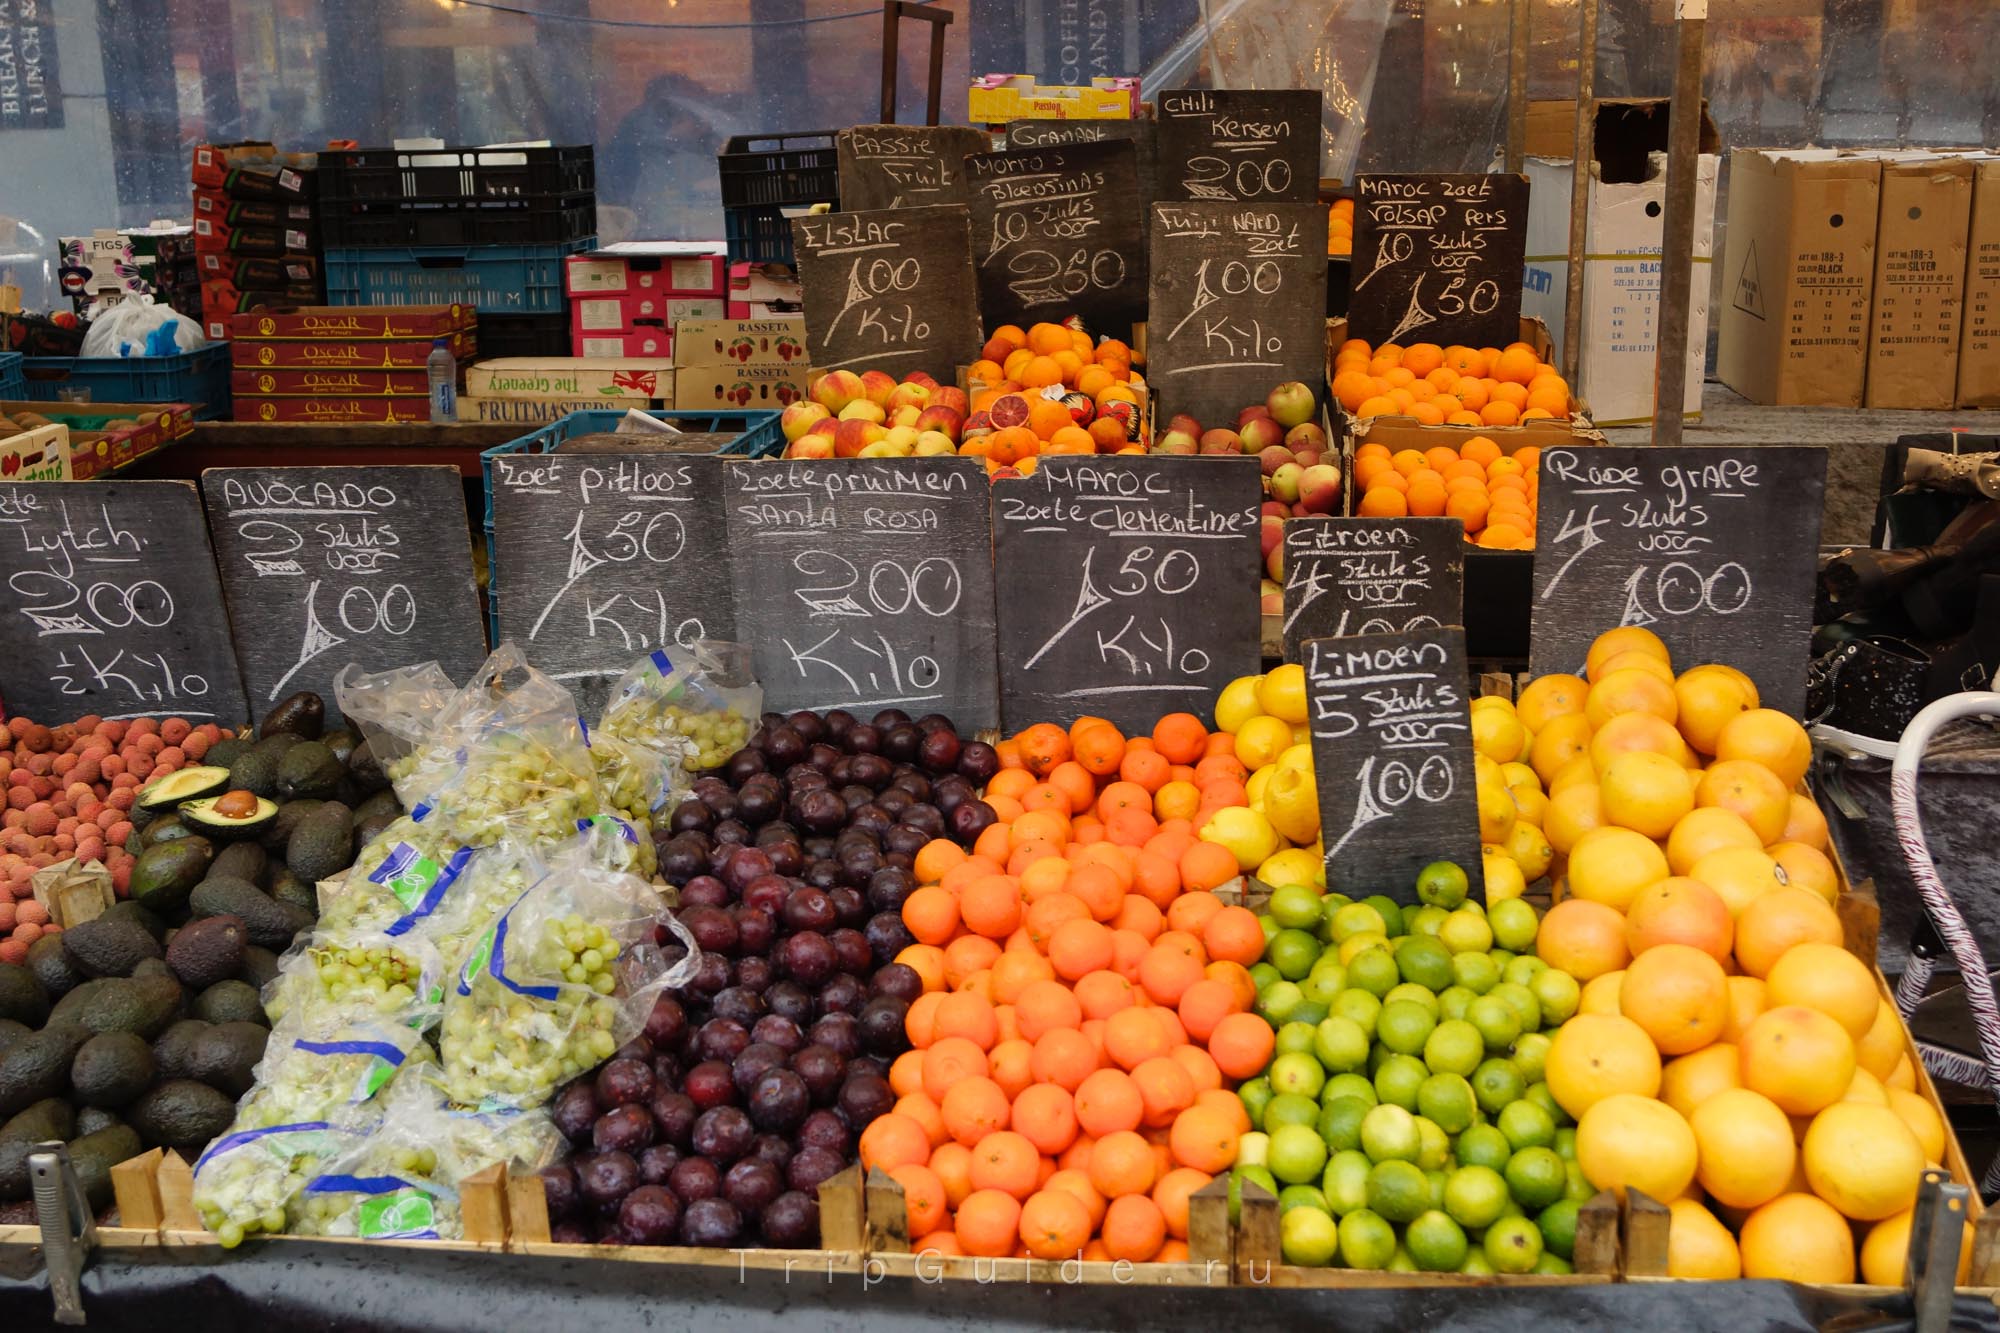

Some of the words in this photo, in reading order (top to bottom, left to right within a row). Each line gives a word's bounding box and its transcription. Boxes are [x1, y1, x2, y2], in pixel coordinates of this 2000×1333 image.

[1033, 101, 1060, 111] Passion
[93, 241, 123, 250] FIGS
[982, 212, 1027, 267] 10
[1355, 233, 1413, 292] 10
[1640, 262, 1662, 273] BLAC
[1818, 264, 1843, 274] BLACK
[1908, 261, 1936, 271] SILVER
[738, 323, 790, 332] RASSETA
[737, 369, 789, 377] RASSETA
[489, 376, 550, 393] Greenery
[555, 377, 579, 393] The
[238, 520, 306, 577] 2
[1542, 504, 1611, 600] 4
[794, 550, 962, 618] 200
[8, 570, 174, 637] 200
[1314, 695, 1359, 738] 5
